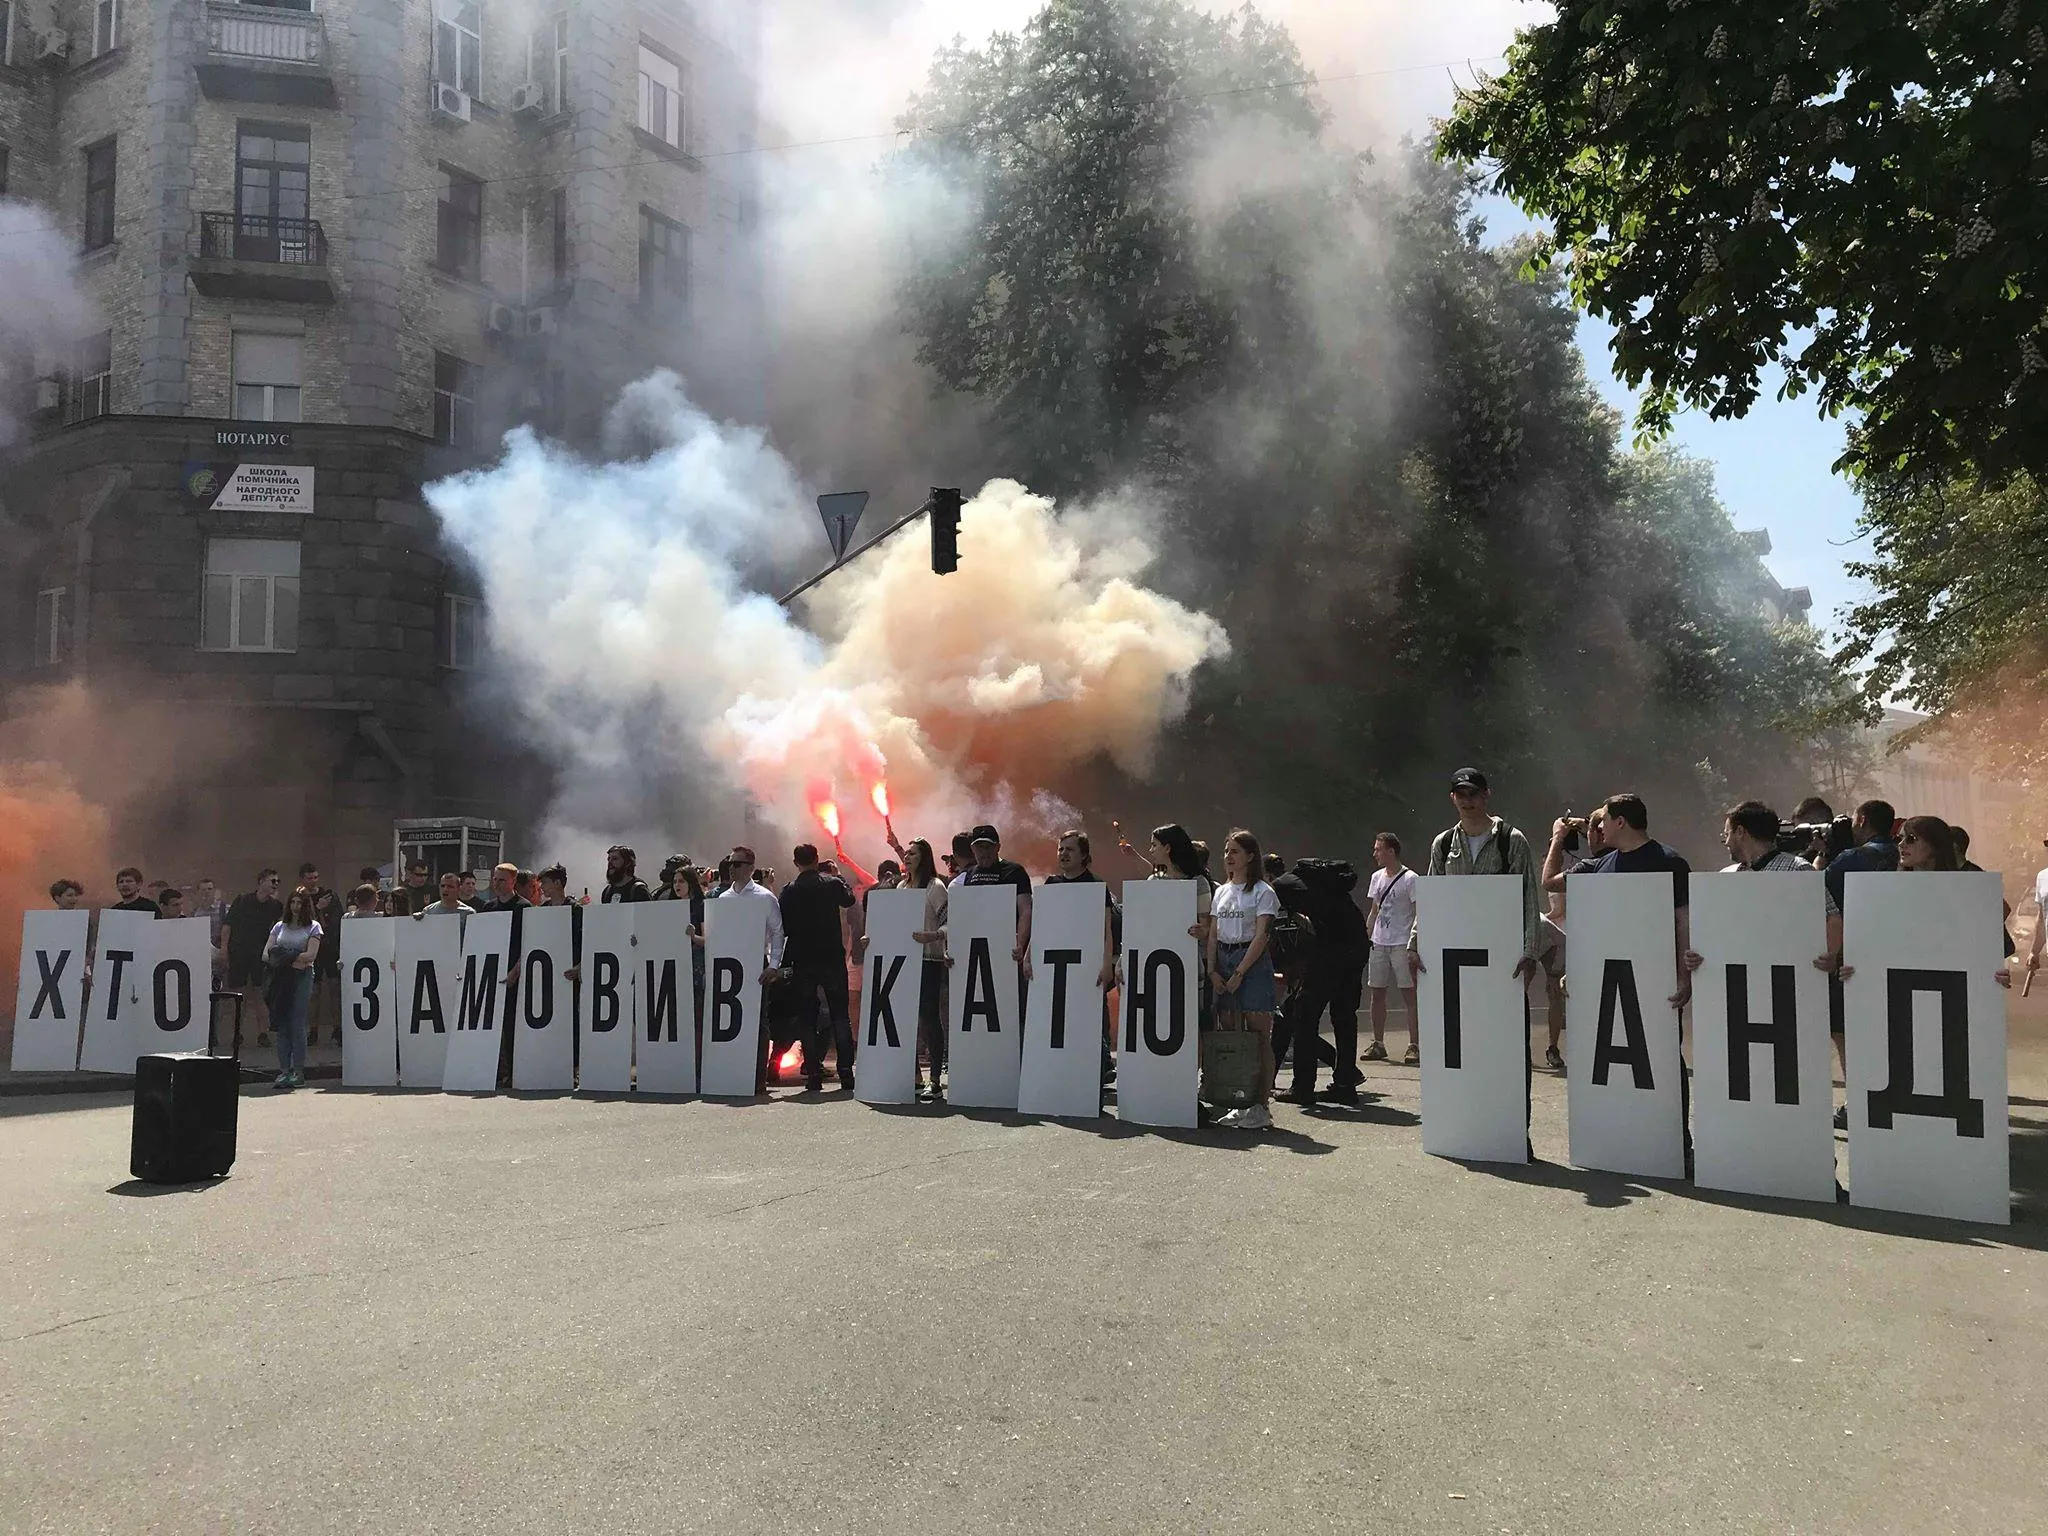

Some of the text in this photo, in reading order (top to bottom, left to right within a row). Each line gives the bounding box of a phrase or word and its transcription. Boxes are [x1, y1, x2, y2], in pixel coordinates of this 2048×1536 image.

[216, 432, 289, 446] НОТАРІУС
[249, 468, 287, 476] ШКОЛА
[237, 476, 299, 484] ПОМІЧНИКА
[236, 486, 300, 495] НАРОДНОГО
[240, 494, 295, 503] ДЕПУТАТА
[1217, 910, 1245, 919] adidas
[29, 937, 1985, 1139] ХТО ЗАМОВИВ КАТЮ ГАНД
